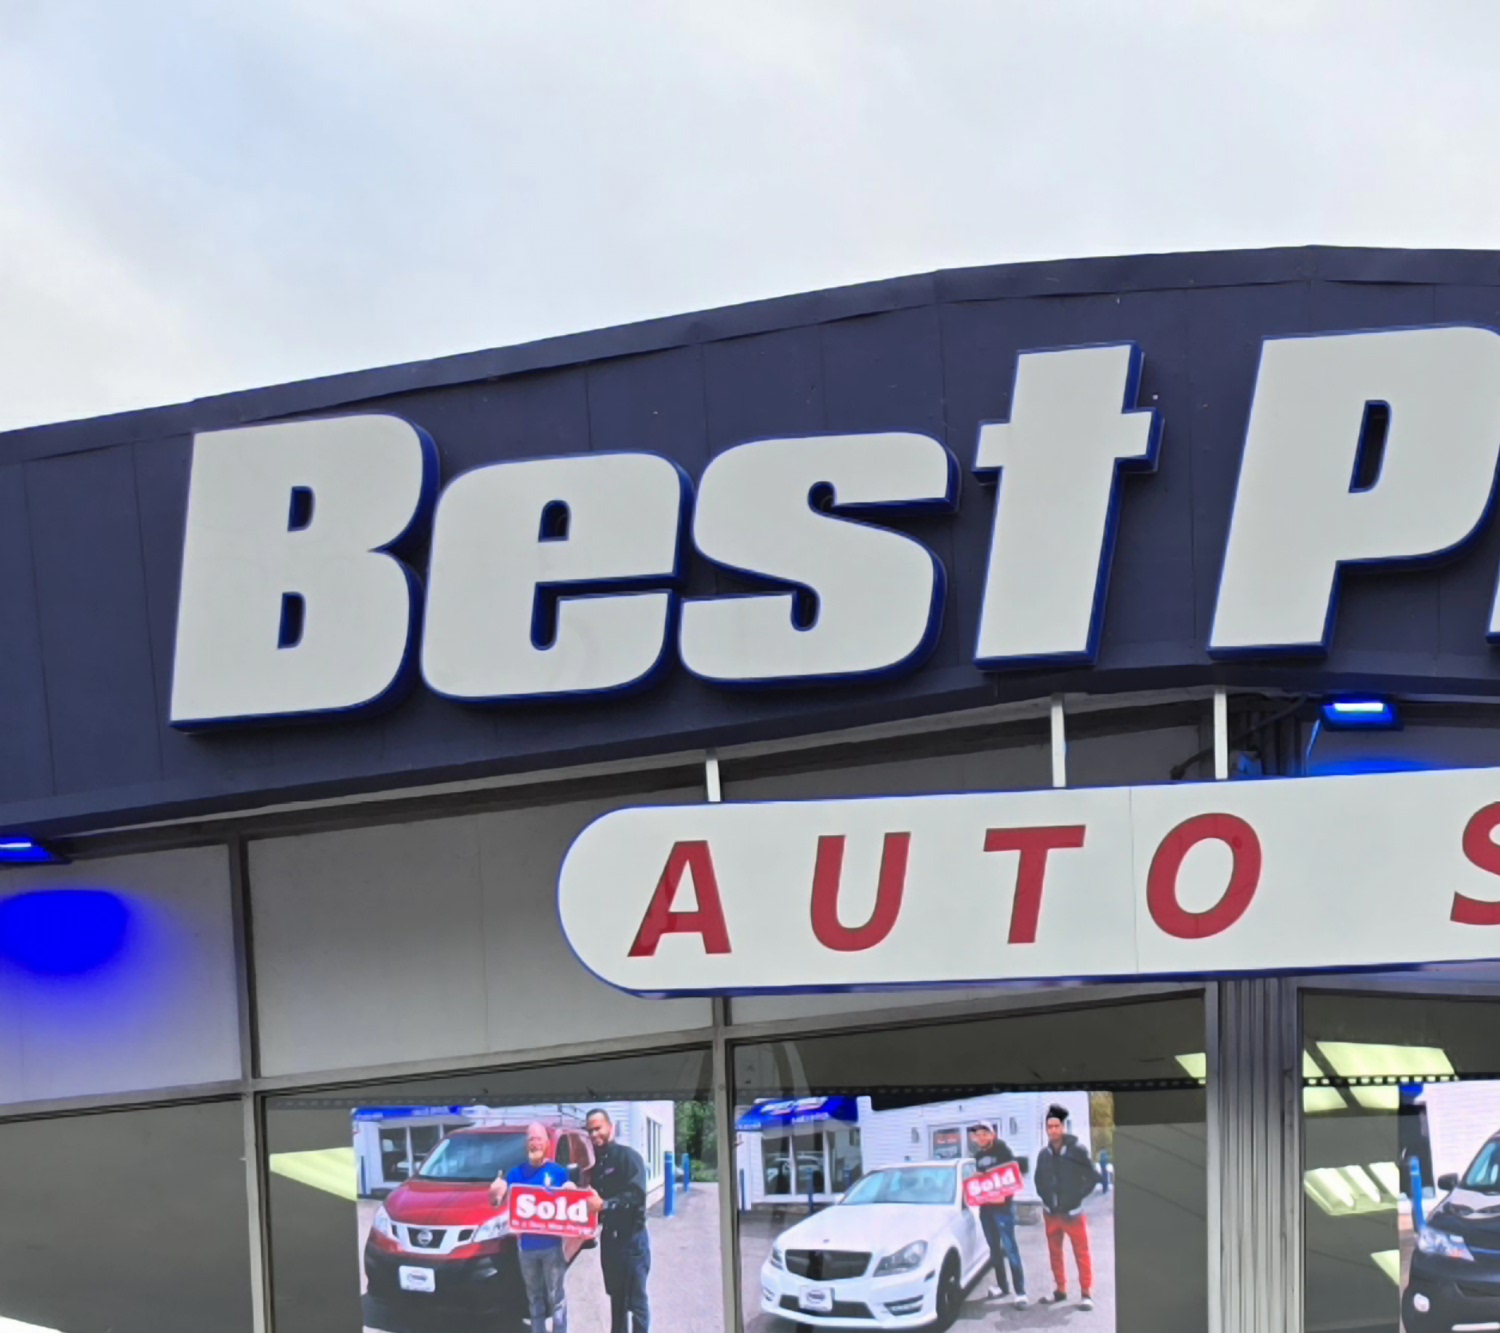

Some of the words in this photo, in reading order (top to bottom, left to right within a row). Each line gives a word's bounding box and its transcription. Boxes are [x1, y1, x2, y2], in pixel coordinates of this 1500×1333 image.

[169, 340, 1162, 728] Best
[627, 818, 1262, 958] AUTO
[516, 1194, 589, 1223] Sold
[966, 1170, 1017, 1197] Sold
